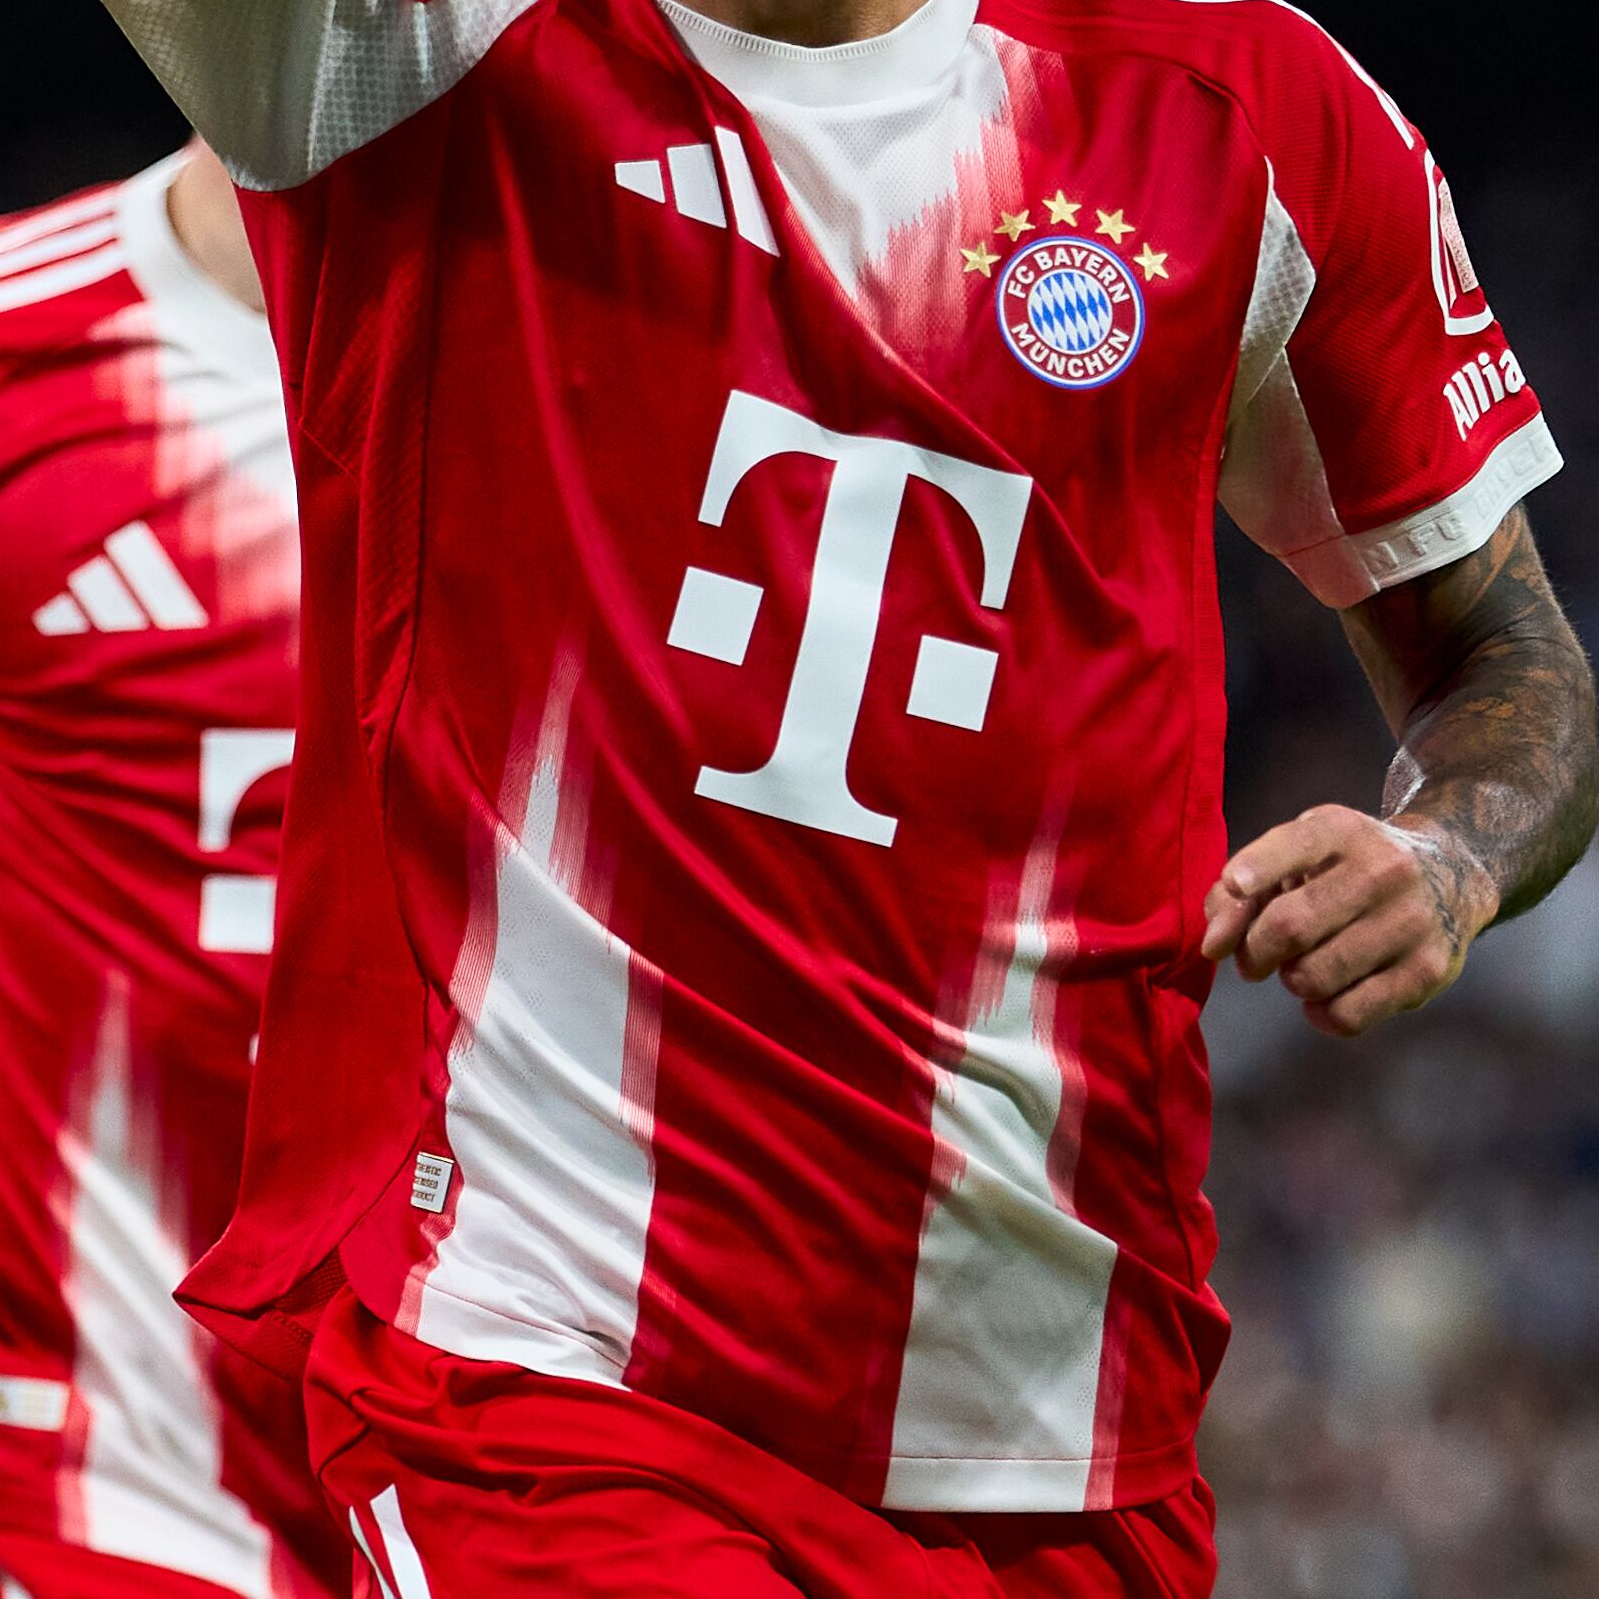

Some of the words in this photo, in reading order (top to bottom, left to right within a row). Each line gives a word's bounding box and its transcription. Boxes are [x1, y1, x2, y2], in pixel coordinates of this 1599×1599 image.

[1007, 265, 1035, 300] FC
[1034, 247, 1131, 304] BAYERN
[1010, 321, 1131, 378] MÜNCHEN
[1443, 348, 1526, 442] Allia
[694, 389, 1034, 849] T
